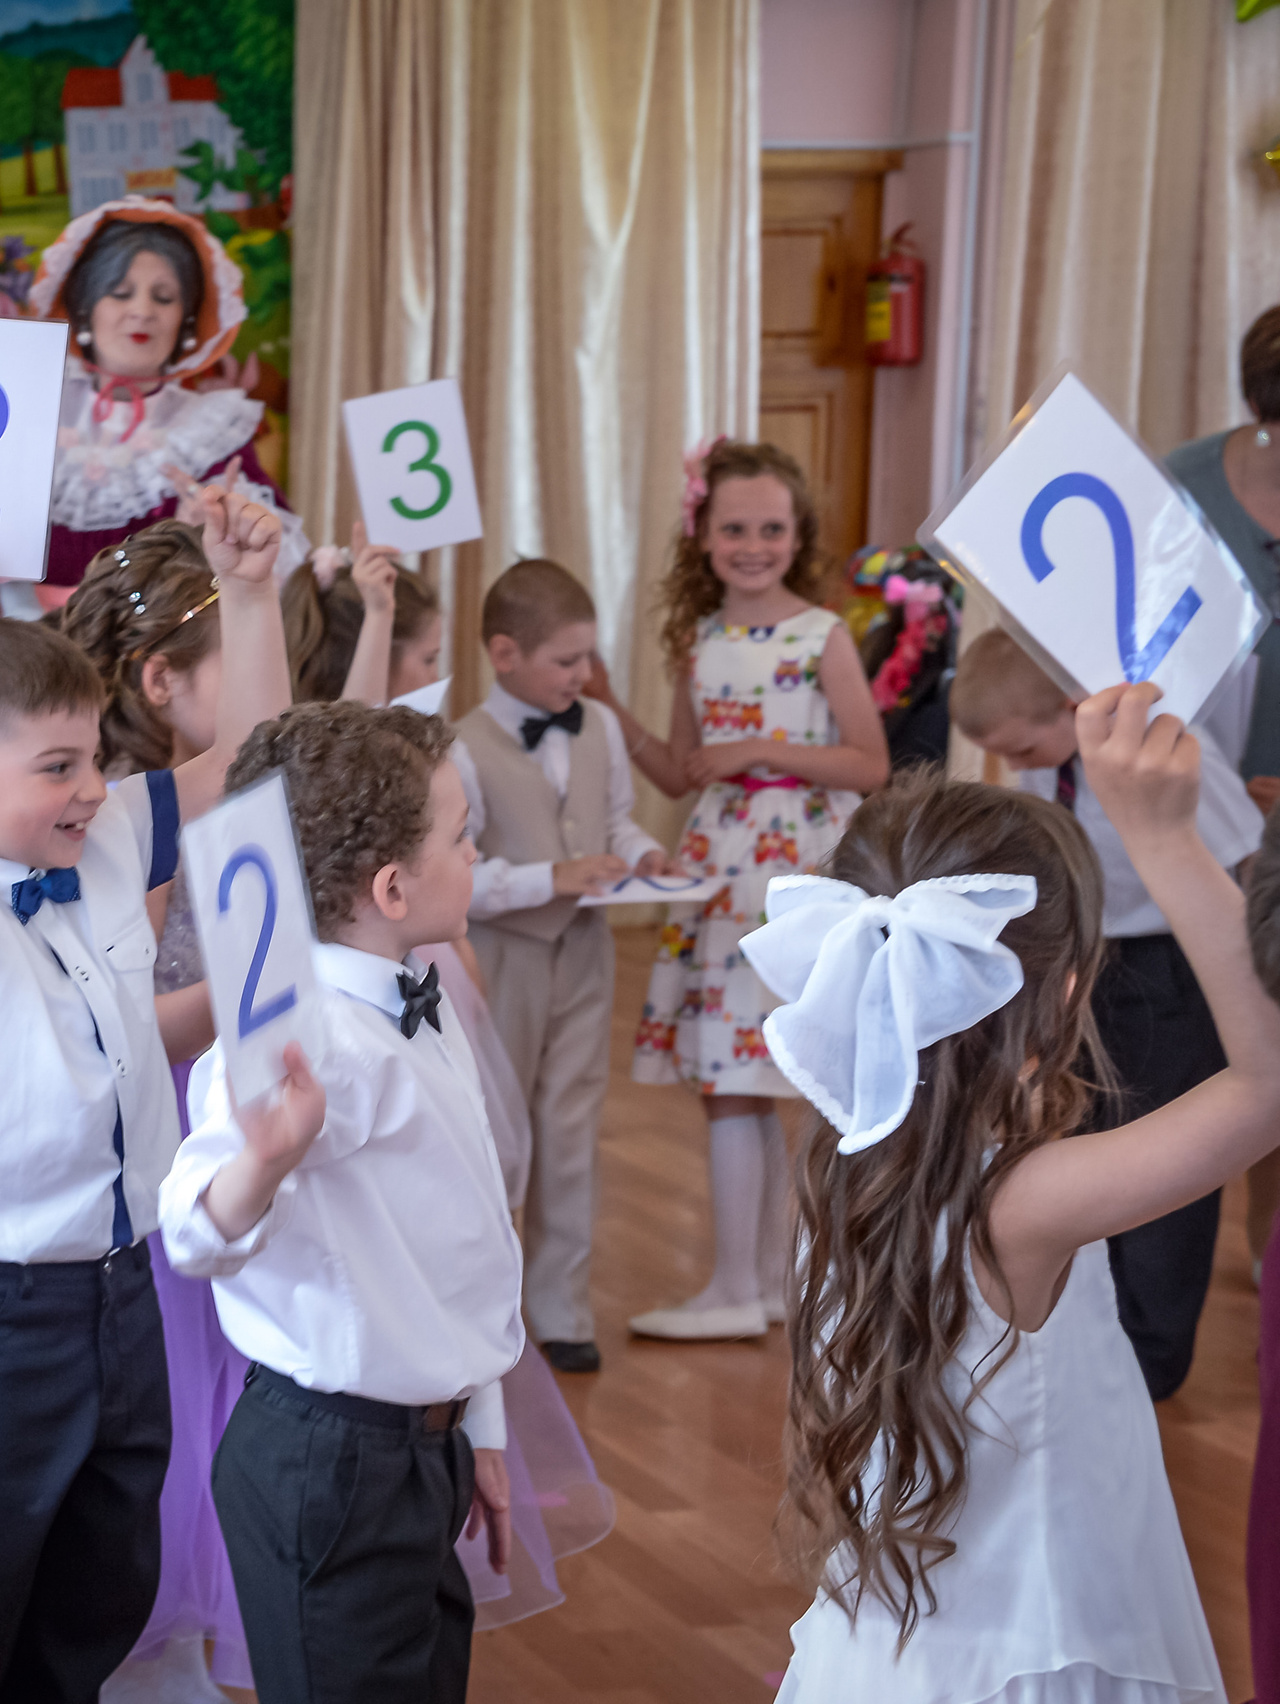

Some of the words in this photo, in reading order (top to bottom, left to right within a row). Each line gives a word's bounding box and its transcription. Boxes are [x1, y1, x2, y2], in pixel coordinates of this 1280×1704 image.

[383, 420, 453, 520] 3
[1019, 471, 1205, 686] 2
[217, 842, 298, 1043] 2
